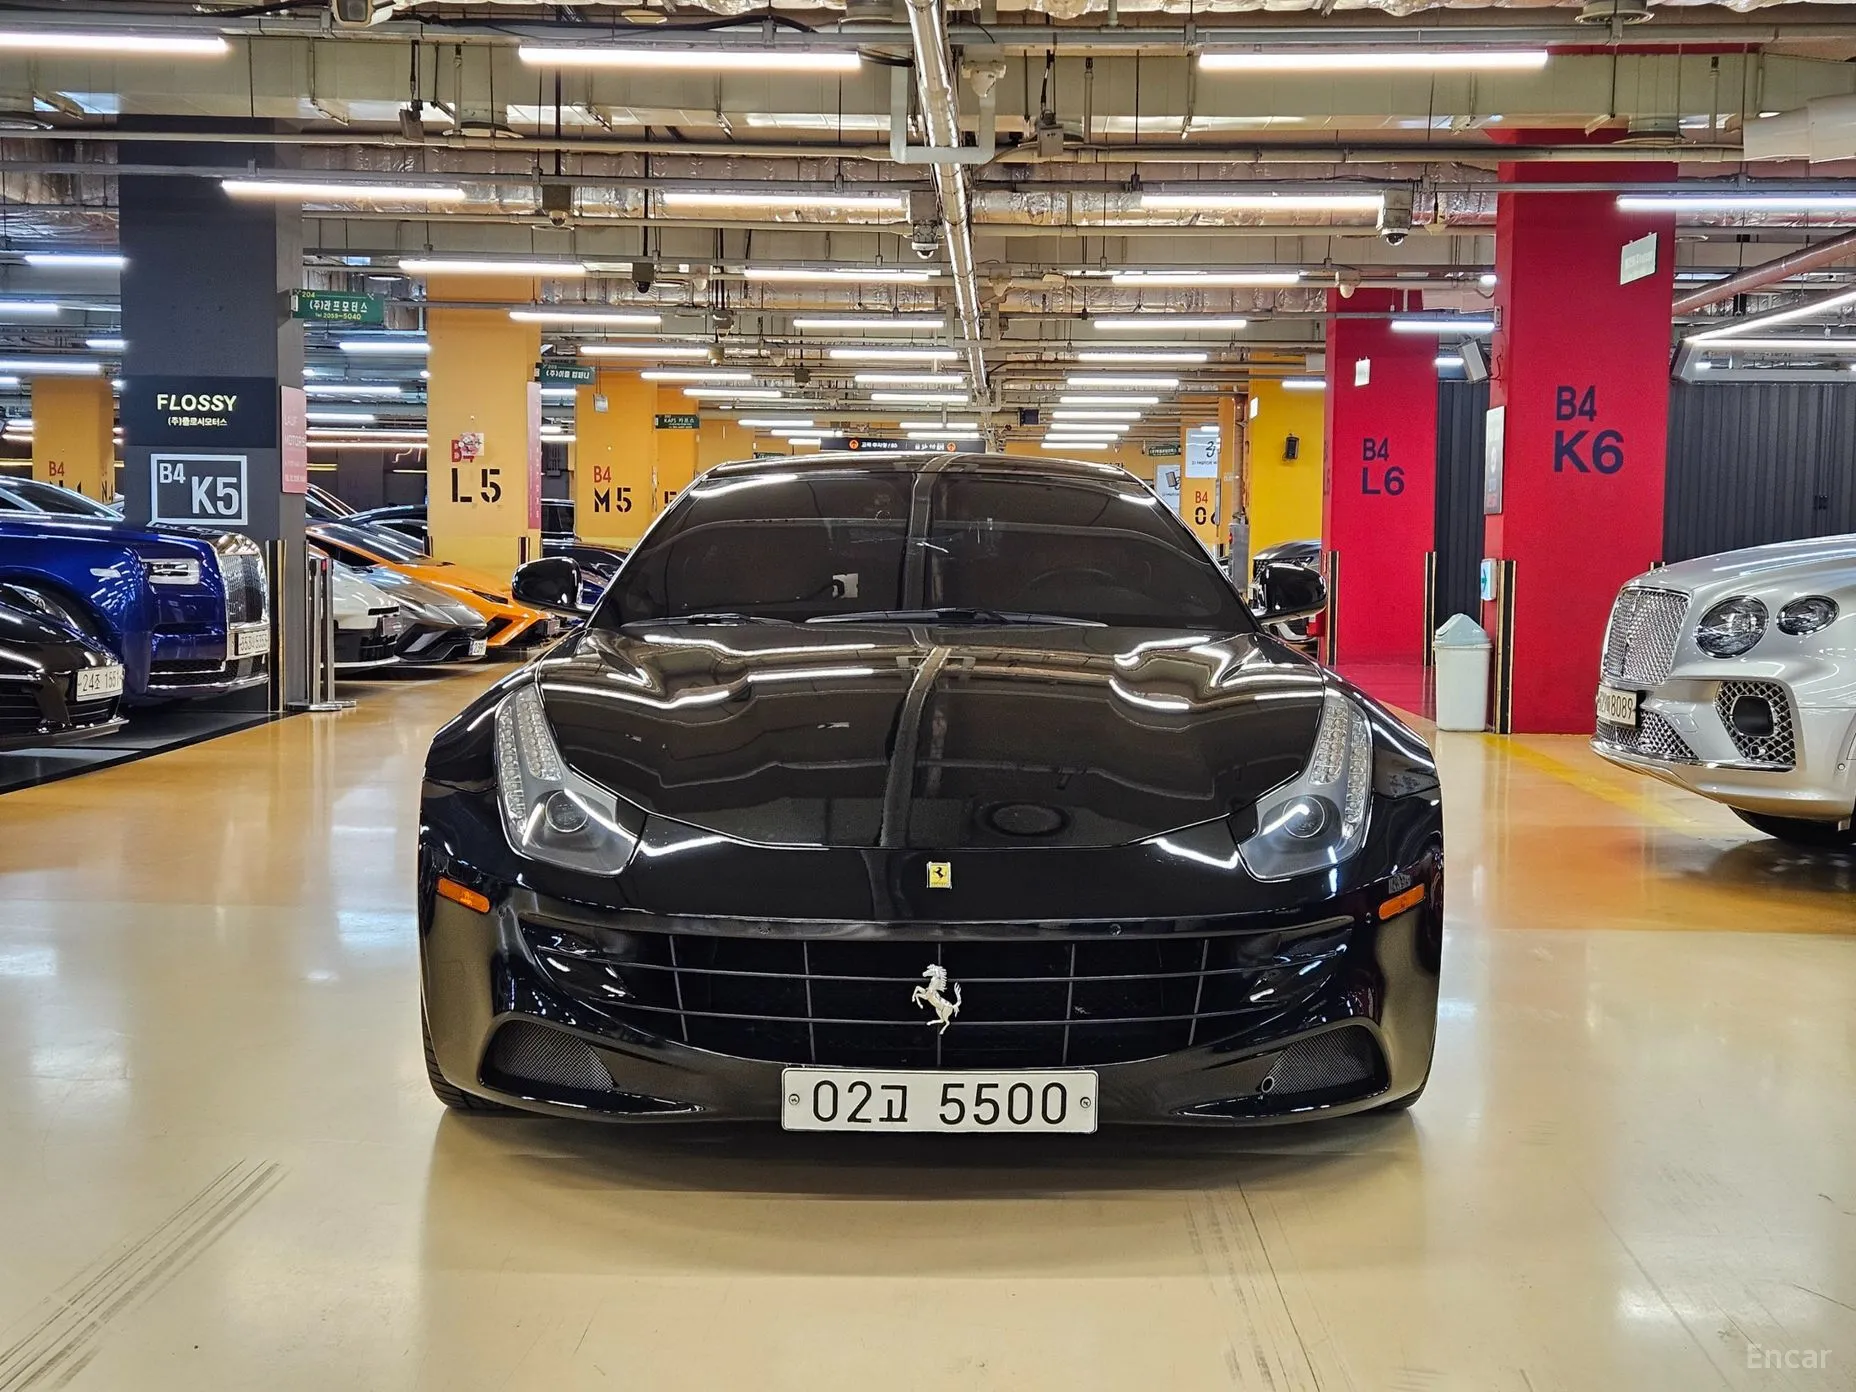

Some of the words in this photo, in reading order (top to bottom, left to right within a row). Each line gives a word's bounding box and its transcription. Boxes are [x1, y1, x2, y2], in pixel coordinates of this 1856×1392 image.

[157, 394, 237, 411] FLOSSY
[1555, 385, 1598, 422] B4
[1362, 437, 1390, 462] B4
[1553, 429, 1624, 475] K6
[48, 460, 65, 477] B4
[159, 462, 186, 484] B4
[593, 465, 611, 484] B4
[1361, 465, 1405, 496] L6
[191, 475, 240, 516] K5
[594, 487, 632, 513] M5
[1195, 491, 1208, 504] B4
[1610, 694, 1634, 720] 8089
[812, 1079, 909, 1124] 02고
[938, 1081, 1068, 1126] 5500
